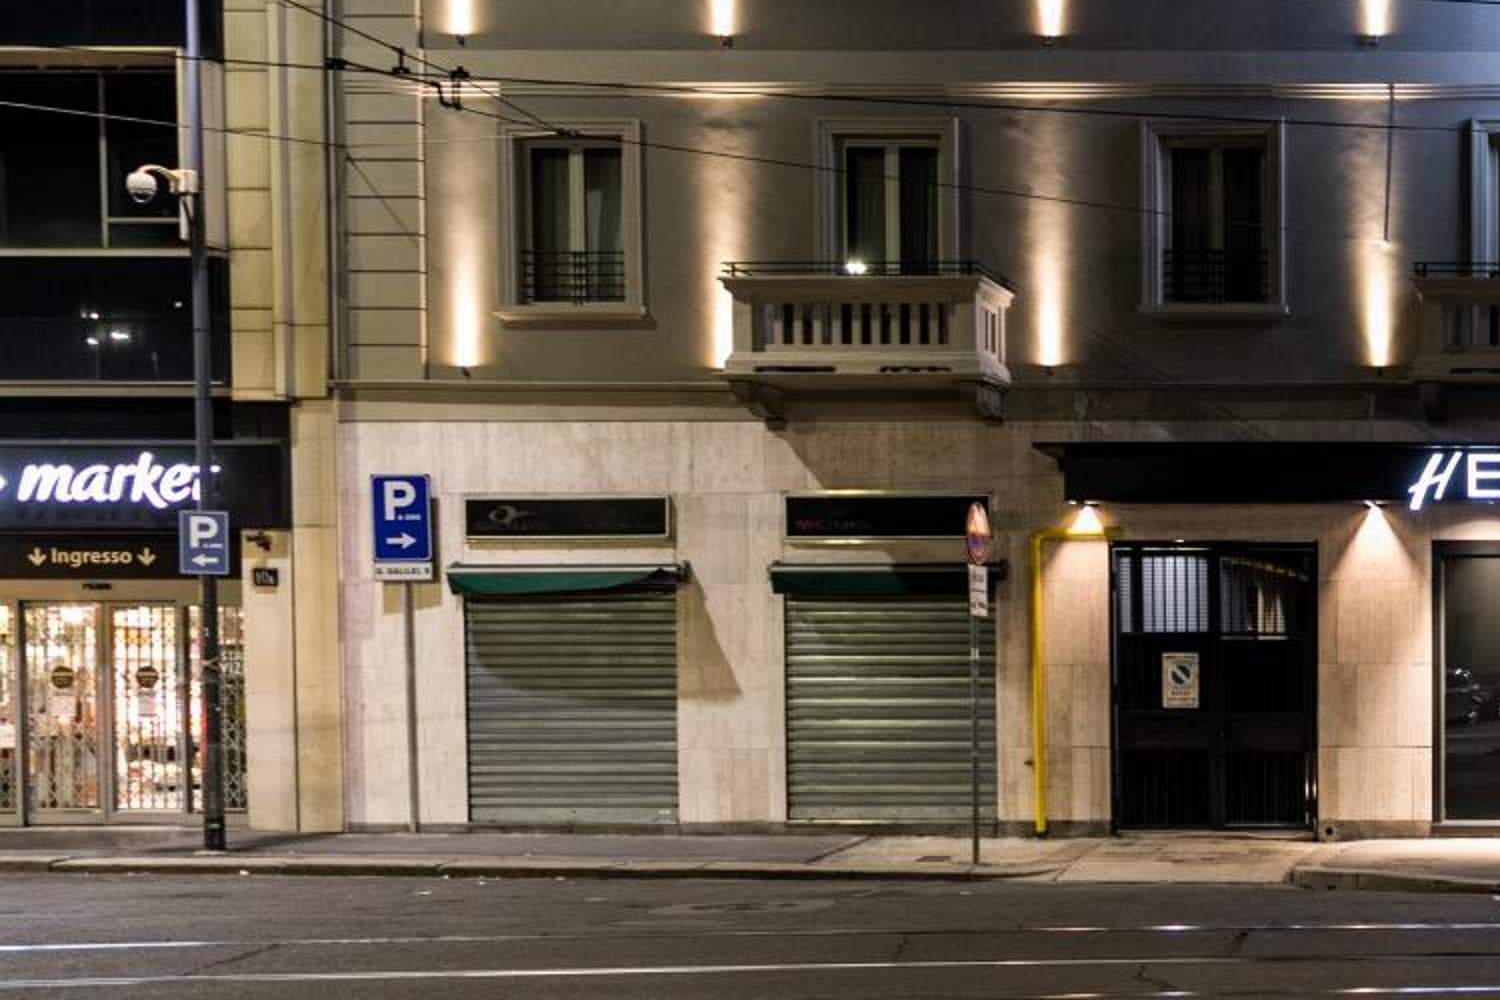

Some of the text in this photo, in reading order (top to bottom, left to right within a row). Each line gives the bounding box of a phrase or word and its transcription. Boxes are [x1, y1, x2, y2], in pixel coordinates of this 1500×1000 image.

[384, 481, 417, 521] P
[190, 515, 219, 548] P
[51, 547, 133, 568] Ingresso
